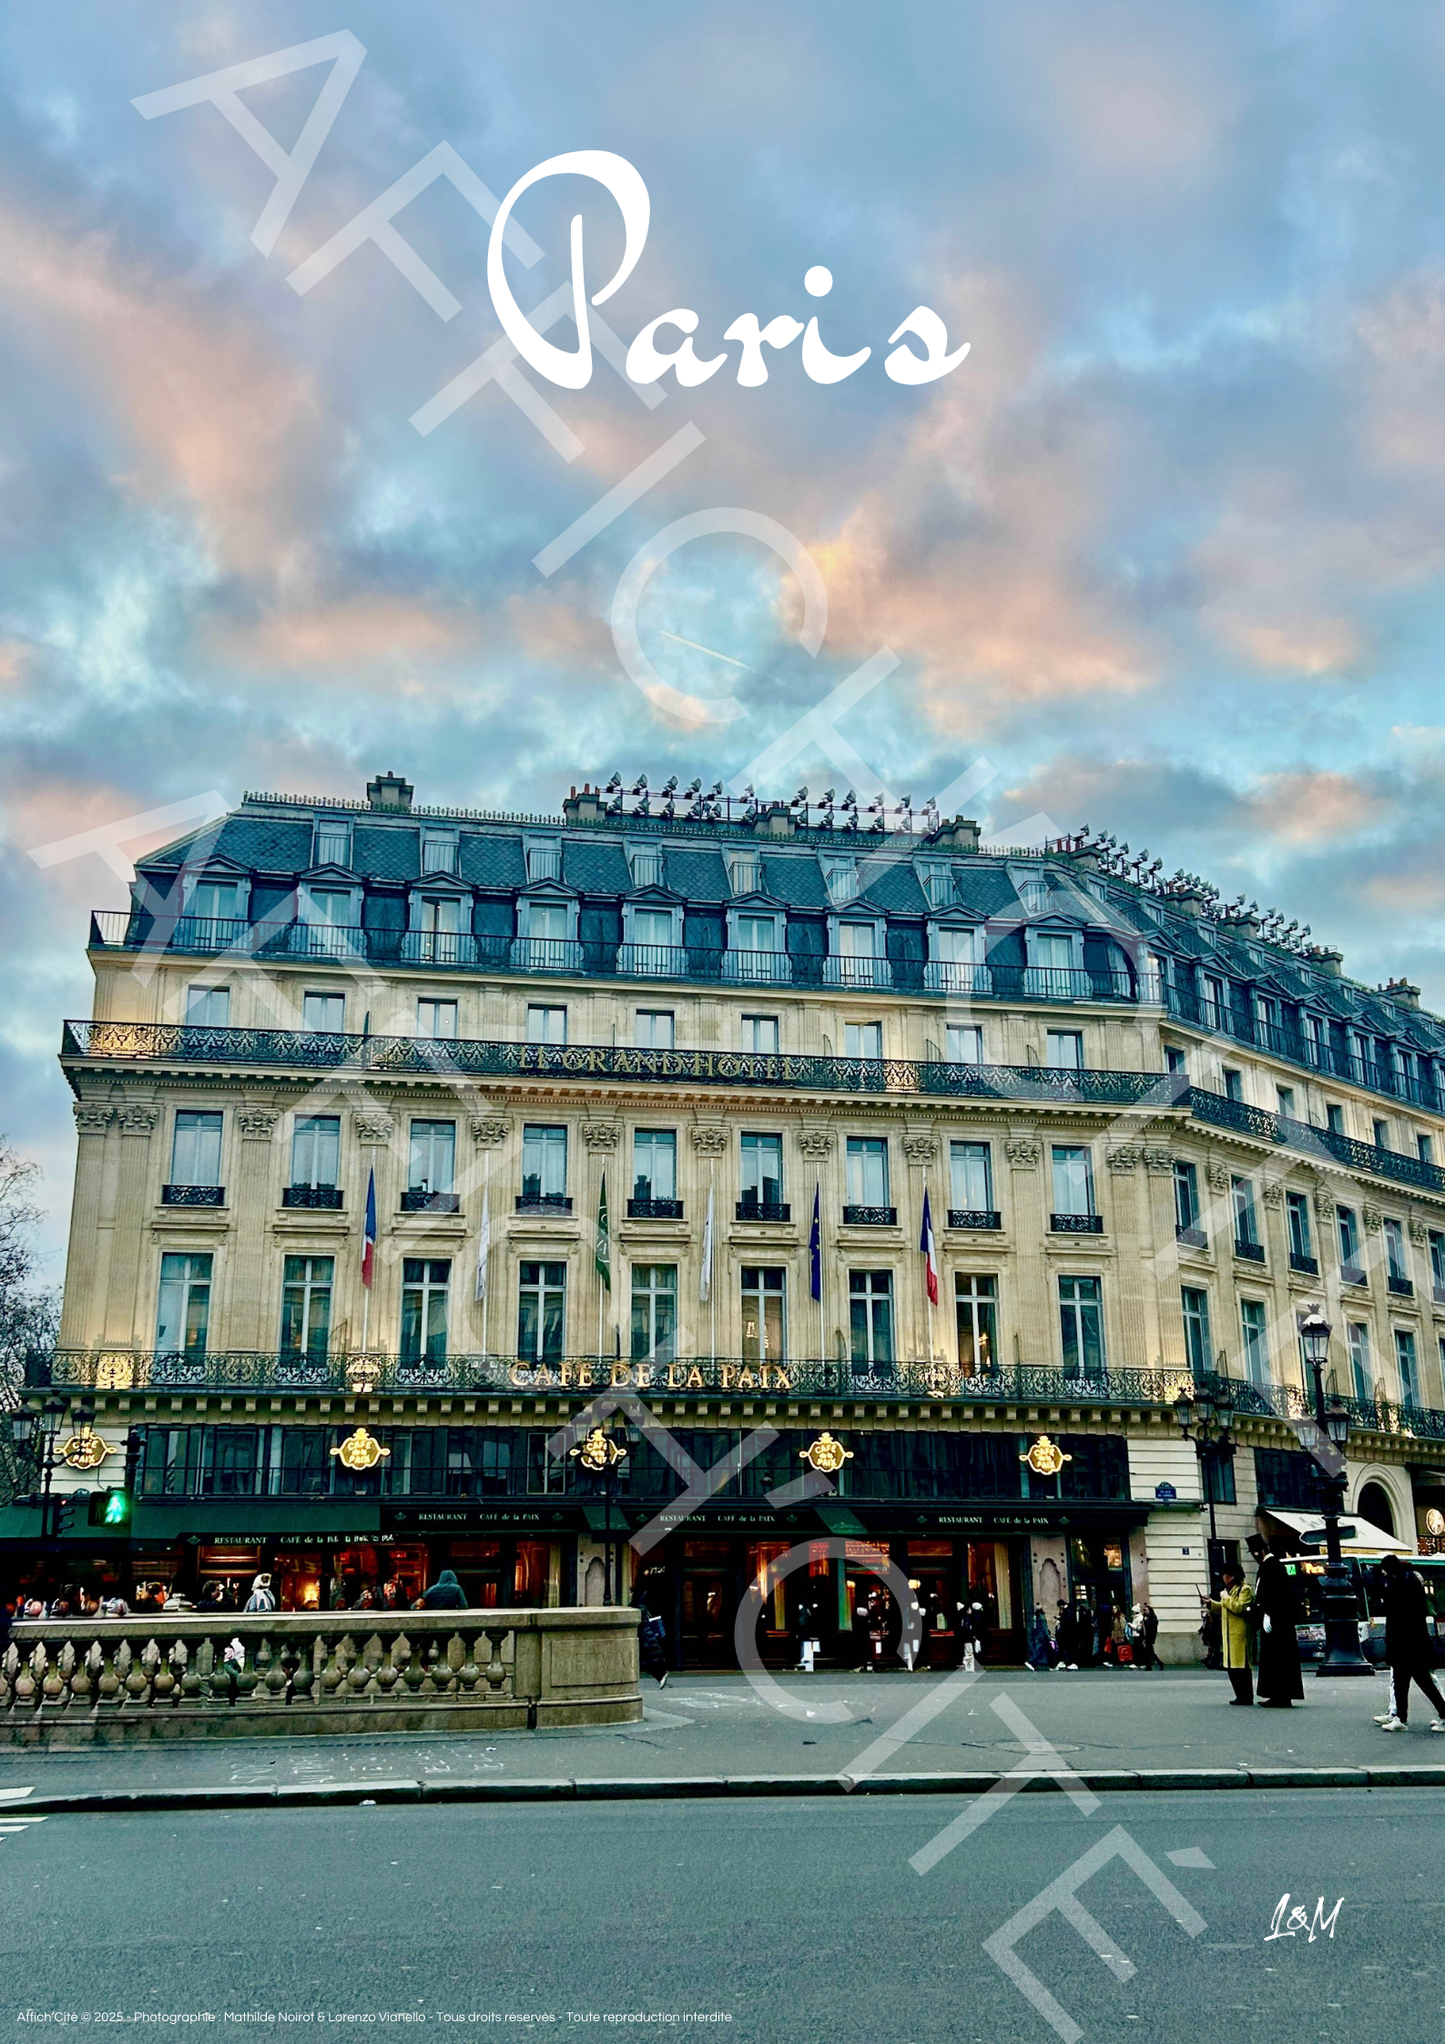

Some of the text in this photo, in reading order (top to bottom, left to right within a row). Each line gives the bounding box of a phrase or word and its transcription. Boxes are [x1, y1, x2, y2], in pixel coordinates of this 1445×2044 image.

[562, 1050, 682, 1076] GRAND
[611, 1363, 650, 1388] DE
[667, 1364, 705, 1388] LA
[720, 1363, 791, 1389] PAIX
[418, 1513, 468, 1521] RESTAURANT
[501, 1513, 510, 1521] de
[513, 1513, 520, 1521] la
[522, 1513, 540, 1521] PAIX
[659, 1514, 707, 1522] RESTAURANT
[738, 1514, 748, 1522] de
[750, 1514, 757, 1522] la
[758, 1514, 775, 1522] PAIX
[938, 1516, 984, 1524] RESTAURANT
[1013, 1517, 1022, 1525] de
[1024, 1517, 1031, 1525] la
[1032, 1517, 1049, 1525] PAIX
[214, 1536, 268, 1544] RESTAURANT
[303, 1536, 313, 1544] de
